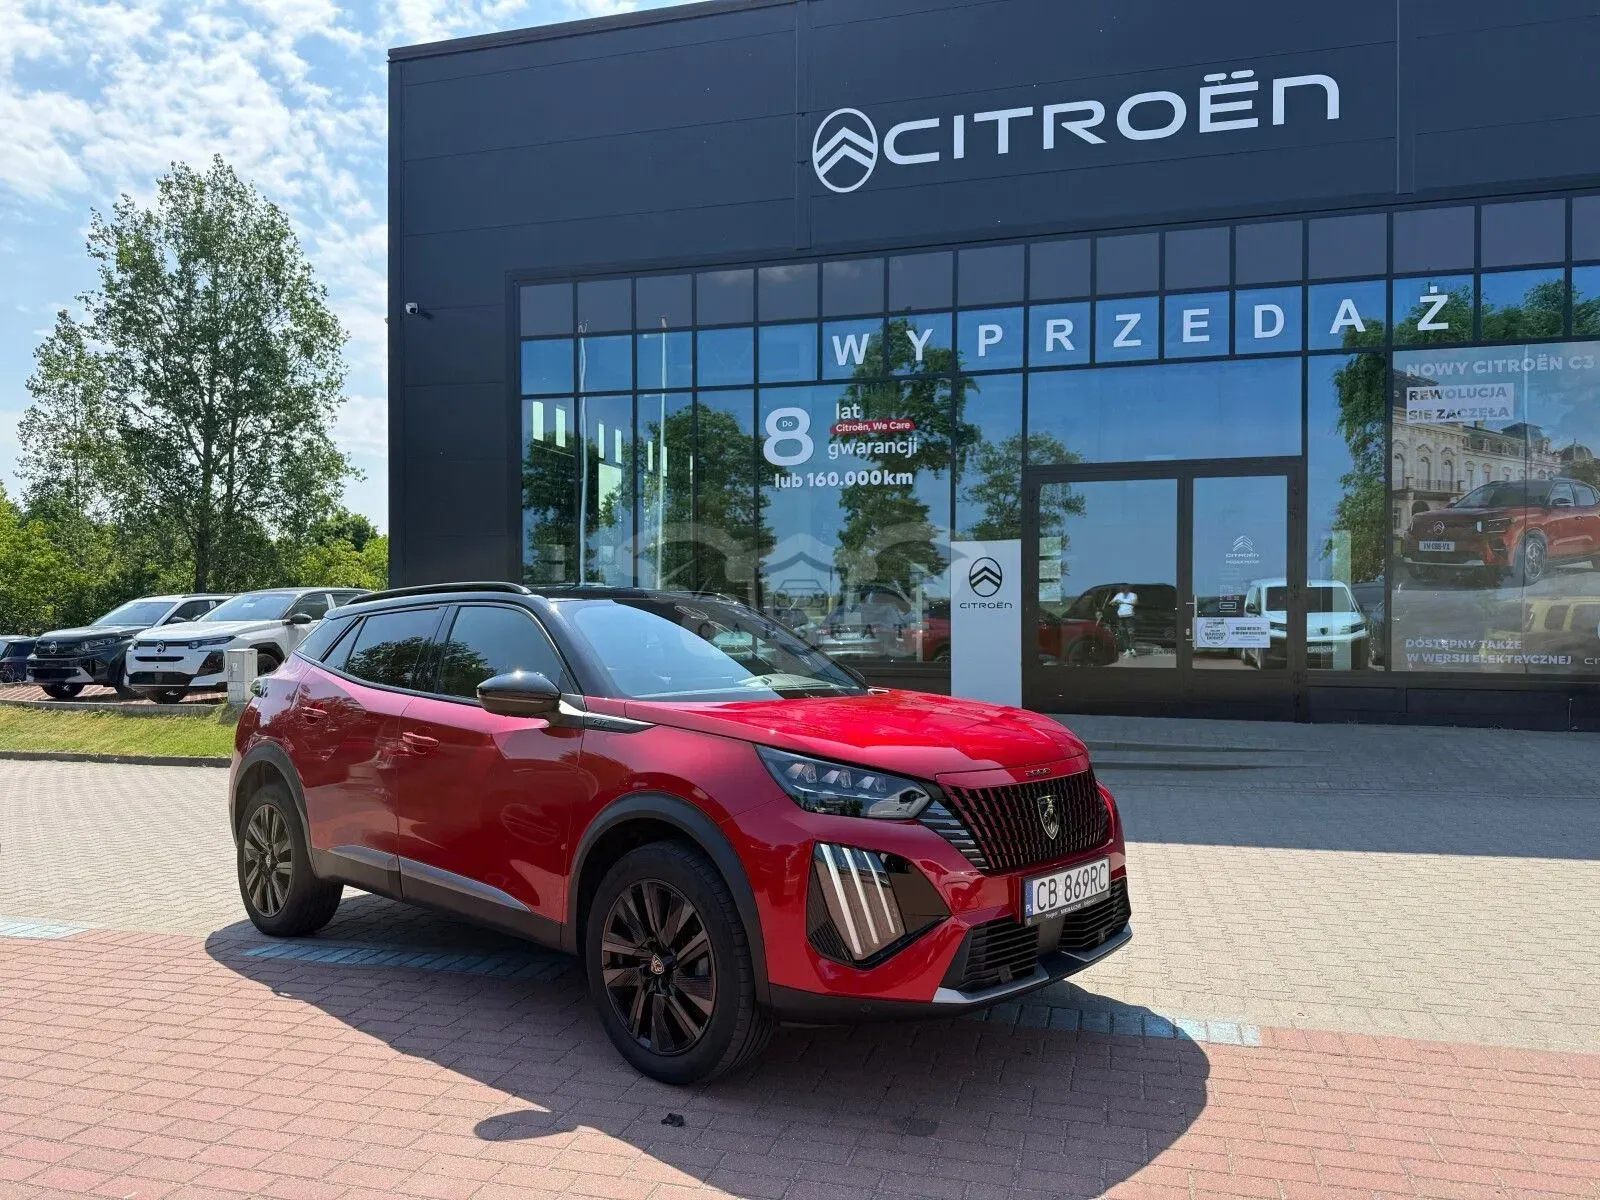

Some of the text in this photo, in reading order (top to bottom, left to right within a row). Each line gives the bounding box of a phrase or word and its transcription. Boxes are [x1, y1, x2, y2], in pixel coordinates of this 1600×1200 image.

[883, 69, 1340, 165] CITROËN
[1406, 353, 1595, 377] NOWY CITROËN C3
[1409, 386, 1507, 401] REWOLUCJA
[835, 403, 861, 420] lat
[782, 419, 793, 428] Do
[835, 421, 911, 432] Citroën, We Care
[763, 407, 814, 466] 8
[828, 438, 918, 460] gwarancji
[774, 474, 803, 488] lub
[1480, 637, 1522, 650] TAKŻE
[1406, 653, 1572, 665] W WERSJI ELEKTRYCZNEJ
[1037, 878, 1057, 911] CB
[1064, 863, 1106, 902] 869RC
